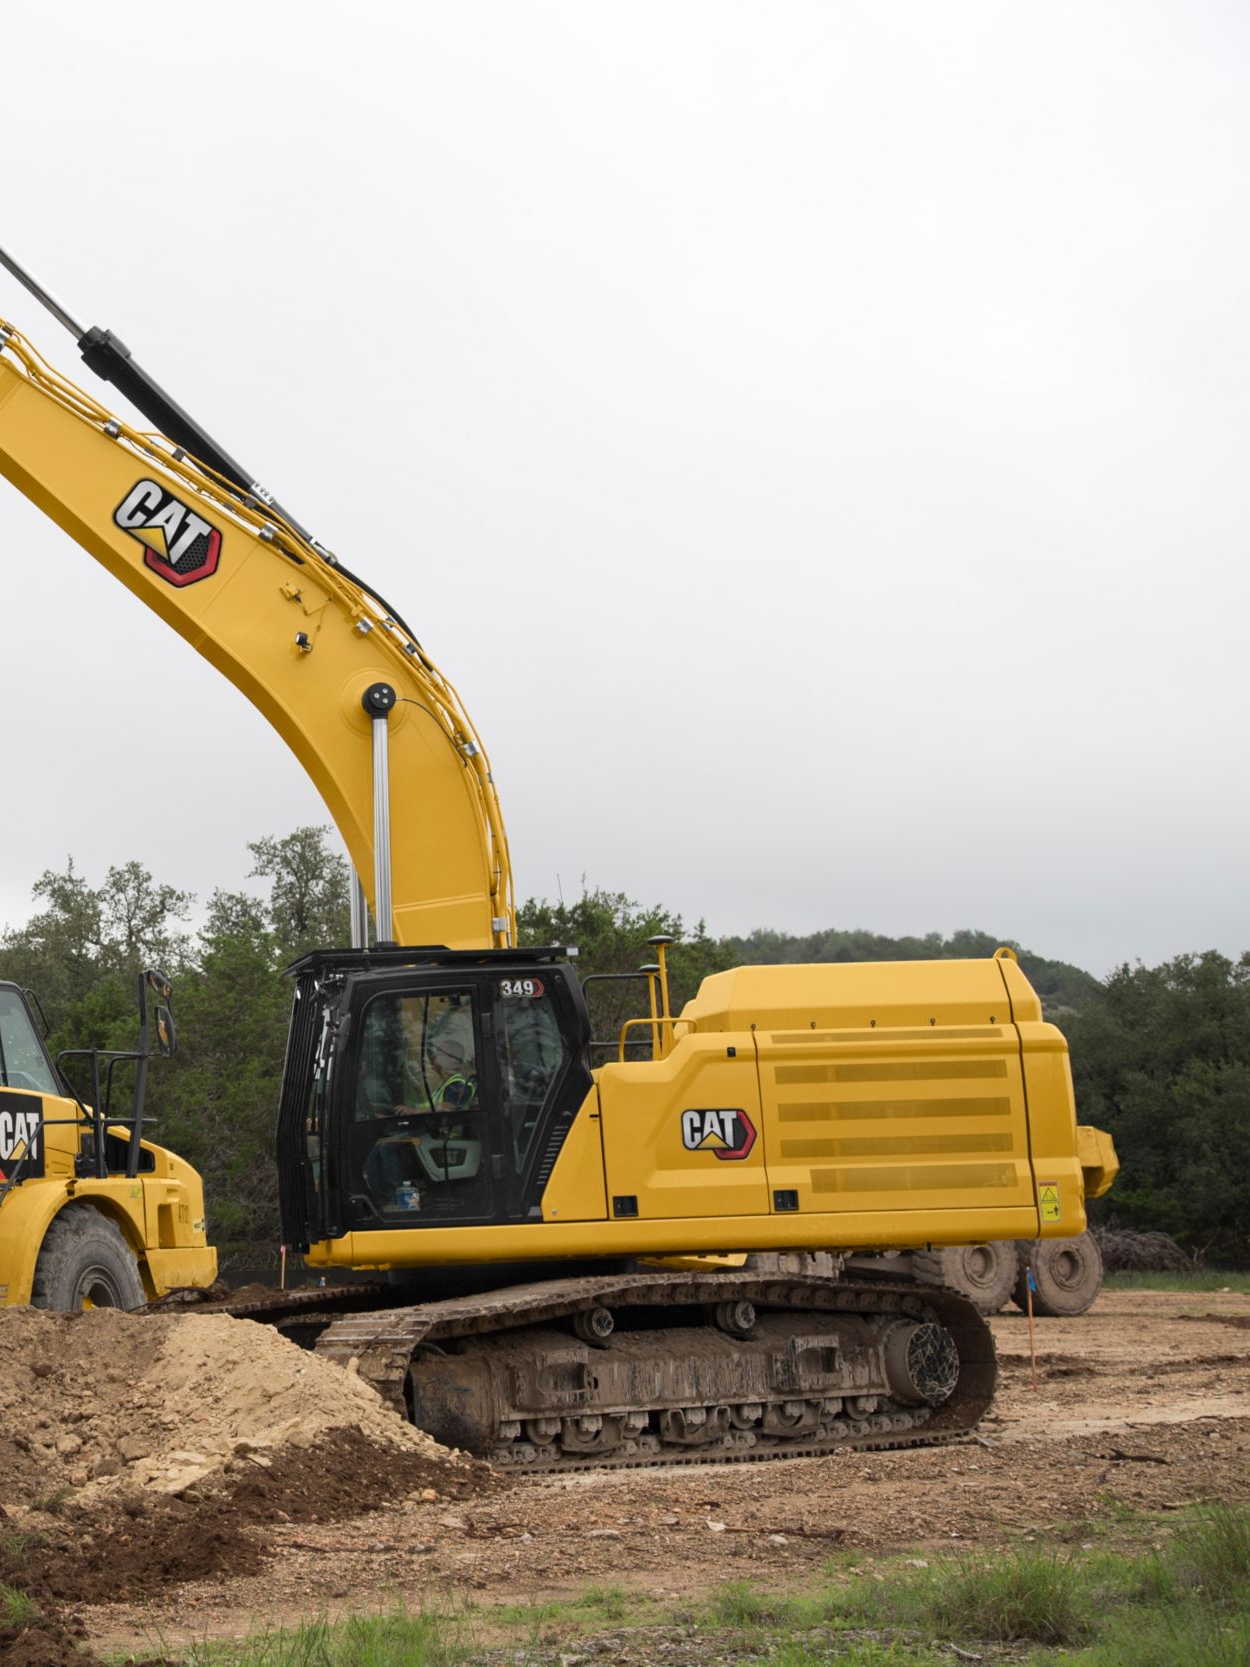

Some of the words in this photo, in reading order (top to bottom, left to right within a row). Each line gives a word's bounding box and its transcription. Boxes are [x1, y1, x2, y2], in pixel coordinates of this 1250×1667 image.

[115, 479, 213, 565] CAT
[501, 980, 534, 996] 349
[682, 1110, 738, 1149] CAT
